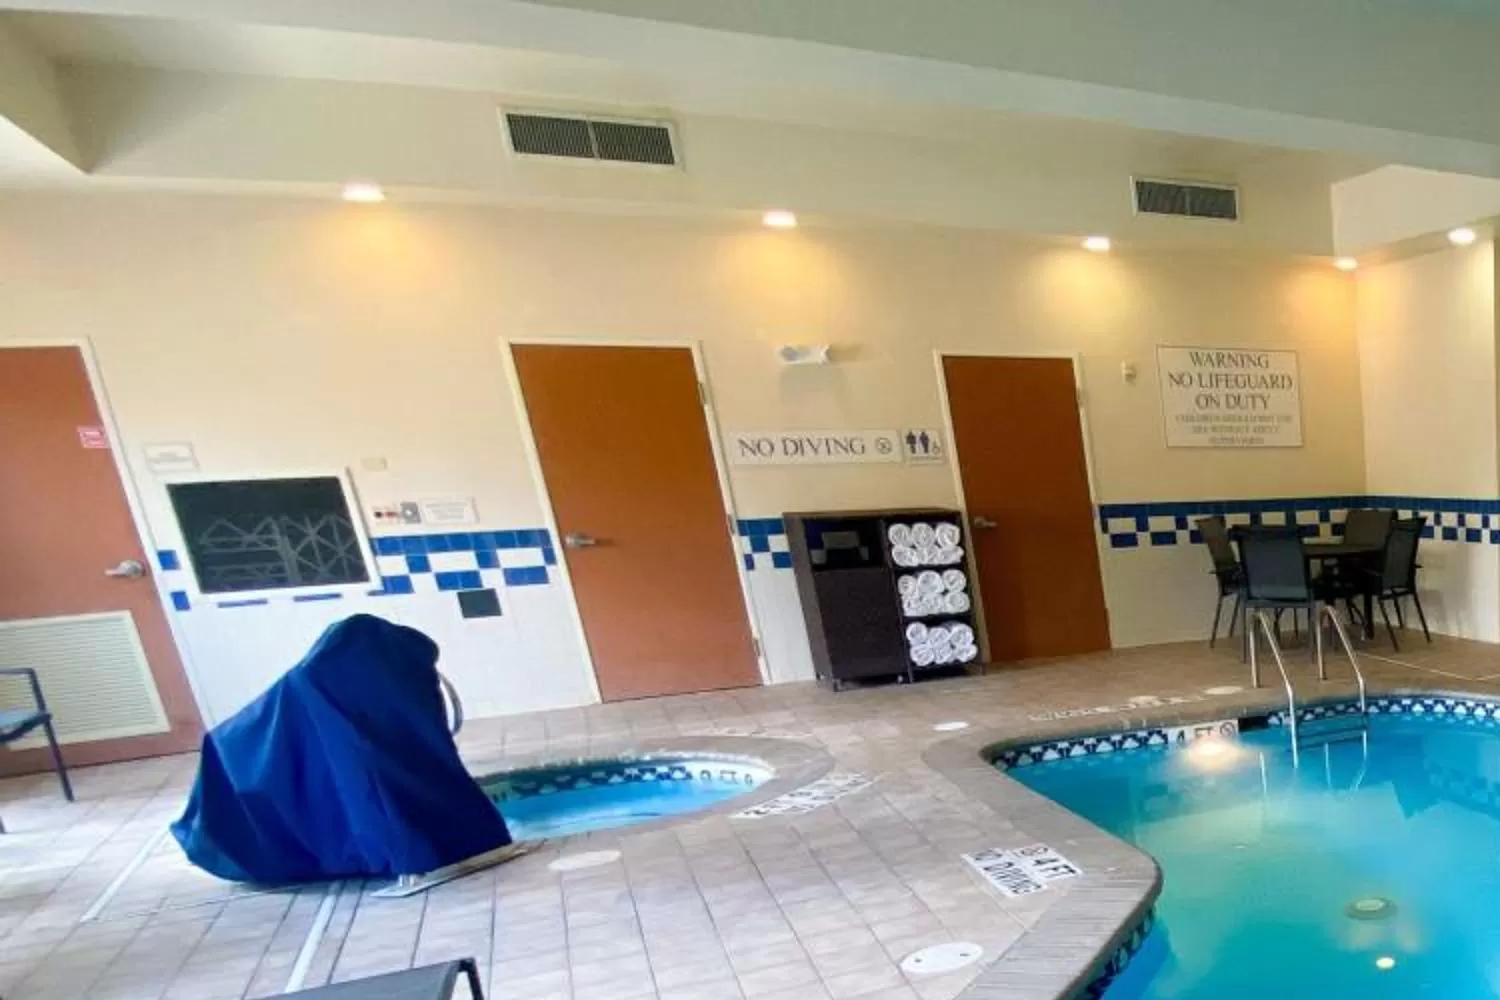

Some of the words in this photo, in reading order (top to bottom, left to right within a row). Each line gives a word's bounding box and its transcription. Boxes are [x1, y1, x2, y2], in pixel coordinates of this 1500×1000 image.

[1188, 351, 1270, 369] WARNING
[1167, 372, 1193, 388] NO
[1199, 372, 1293, 390] LIFEGUARD
[1194, 394, 1221, 410] ON
[1226, 393, 1270, 411] DUTY
[737, 437, 775, 456] NO
[782, 437, 866, 456] DIVING
